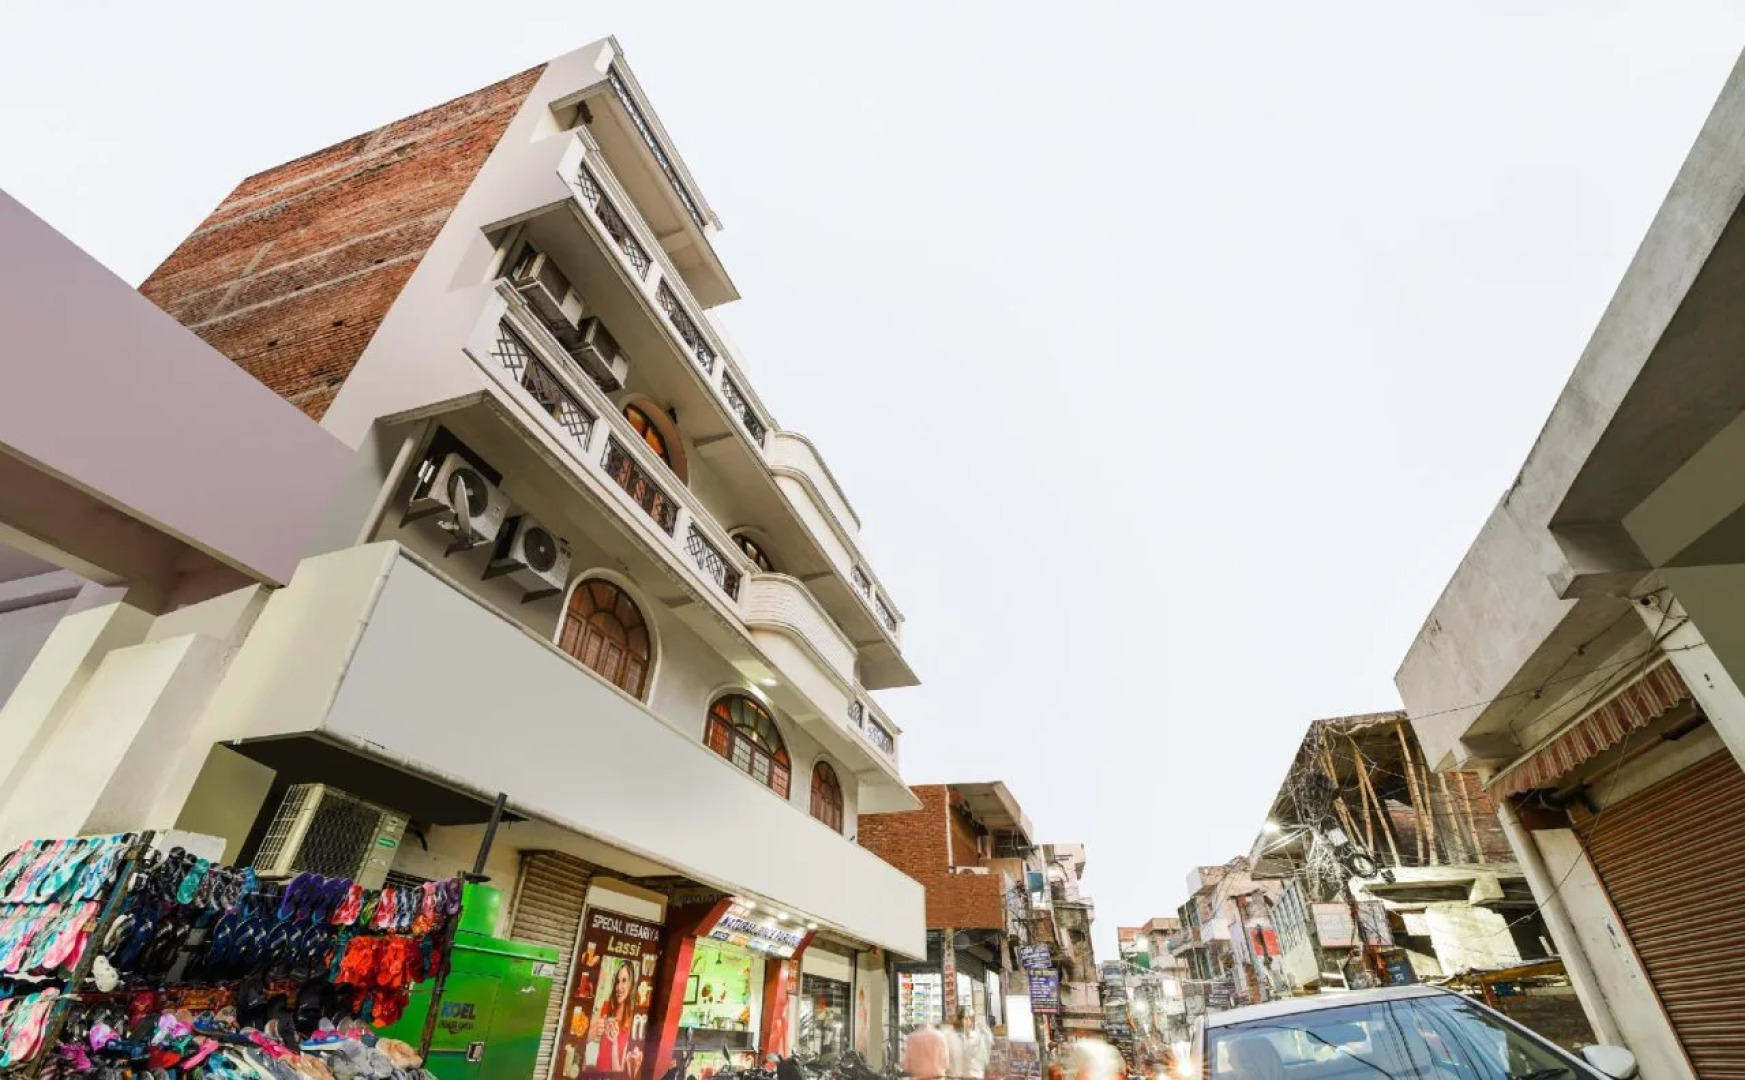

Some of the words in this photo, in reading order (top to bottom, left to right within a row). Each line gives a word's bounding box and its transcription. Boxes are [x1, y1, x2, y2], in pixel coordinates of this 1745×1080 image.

[592, 914, 624, 934] SPECIAL
[607, 936, 642, 957] Lassi
[442, 1002, 476, 1020] KOEL
